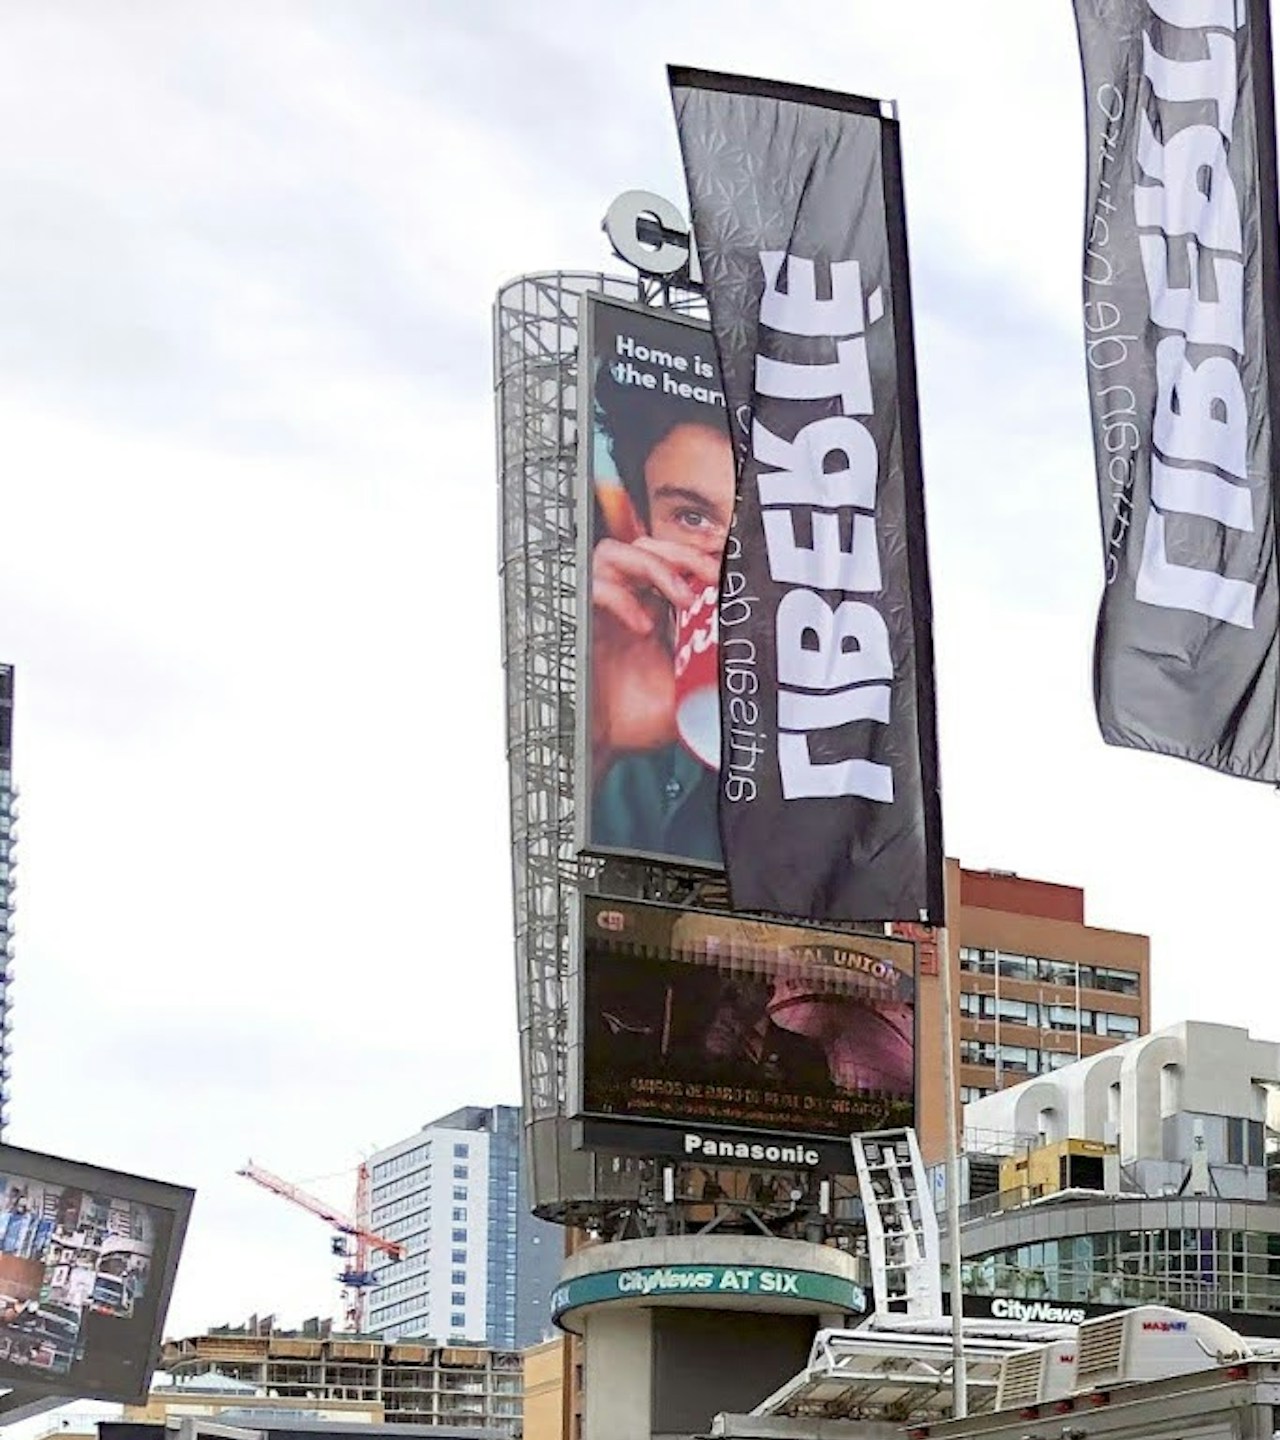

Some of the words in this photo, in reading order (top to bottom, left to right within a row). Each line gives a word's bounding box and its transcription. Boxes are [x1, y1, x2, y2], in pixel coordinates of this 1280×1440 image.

[615, 334, 688, 371] Home
[694, 355, 714, 378] is
[615, 361, 657, 389] the
[684, 1133, 820, 1167] Panasonic
[617, 1270, 713, 1294] CityNews
[719, 1270, 752, 1290] AT
[758, 1271, 800, 1295] SIX
[991, 1299, 1085, 1323] CityNews
